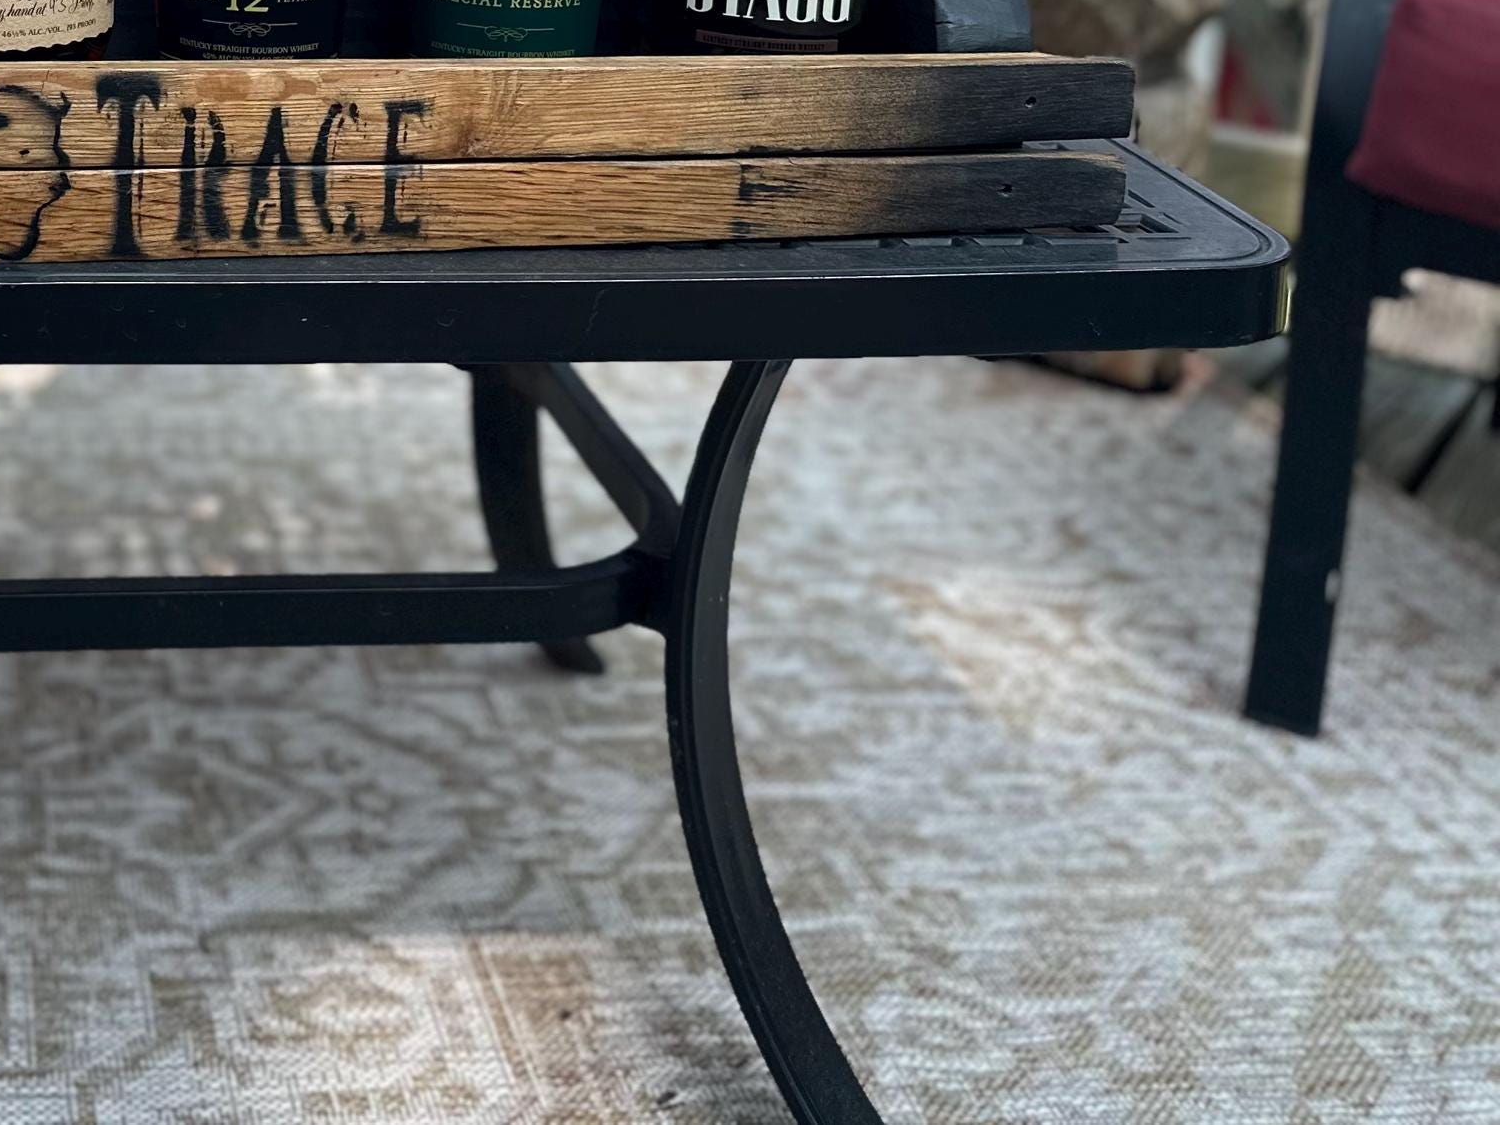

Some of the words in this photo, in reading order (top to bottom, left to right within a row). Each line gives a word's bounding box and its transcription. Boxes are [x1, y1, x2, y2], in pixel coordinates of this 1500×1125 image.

[6, 3, 37, 17] hand
[35, 2, 48, 17] at
[212, 44, 250, 54] STRAIGHT
[251, 46, 289, 54] BOURBON
[95, 70, 435, 257] TRACE
